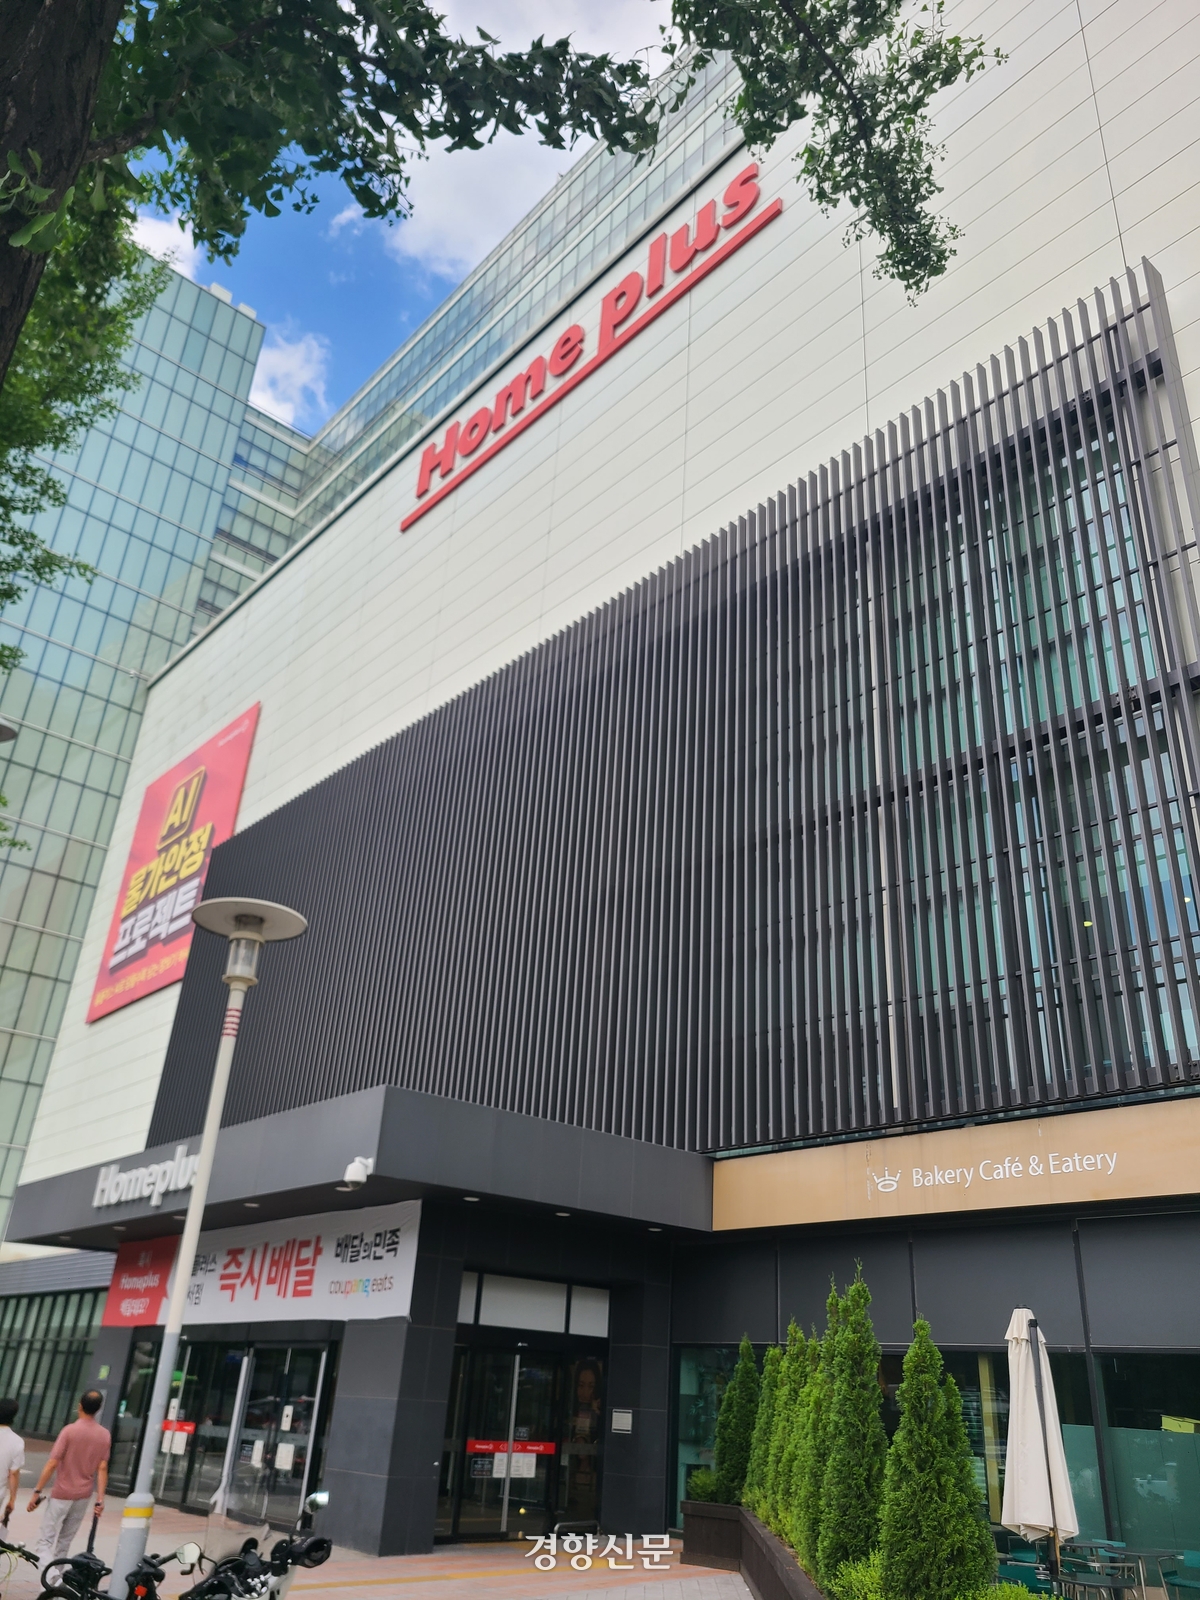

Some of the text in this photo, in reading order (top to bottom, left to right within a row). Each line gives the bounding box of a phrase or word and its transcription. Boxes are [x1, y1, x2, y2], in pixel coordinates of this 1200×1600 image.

[159, 775, 201, 839] AI
[120, 822, 214, 920] 물가안정
[108, 876, 201, 972] 프로젝트
[911, 1152, 1117, 1188] Bakery Café & Eatery
[219, 1235, 323, 1303] 즉시배달
[334, 1227, 401, 1263] 배달의민족
[119, 1270, 160, 1293] Homeplus
[329, 1274, 394, 1299] coupang eats
